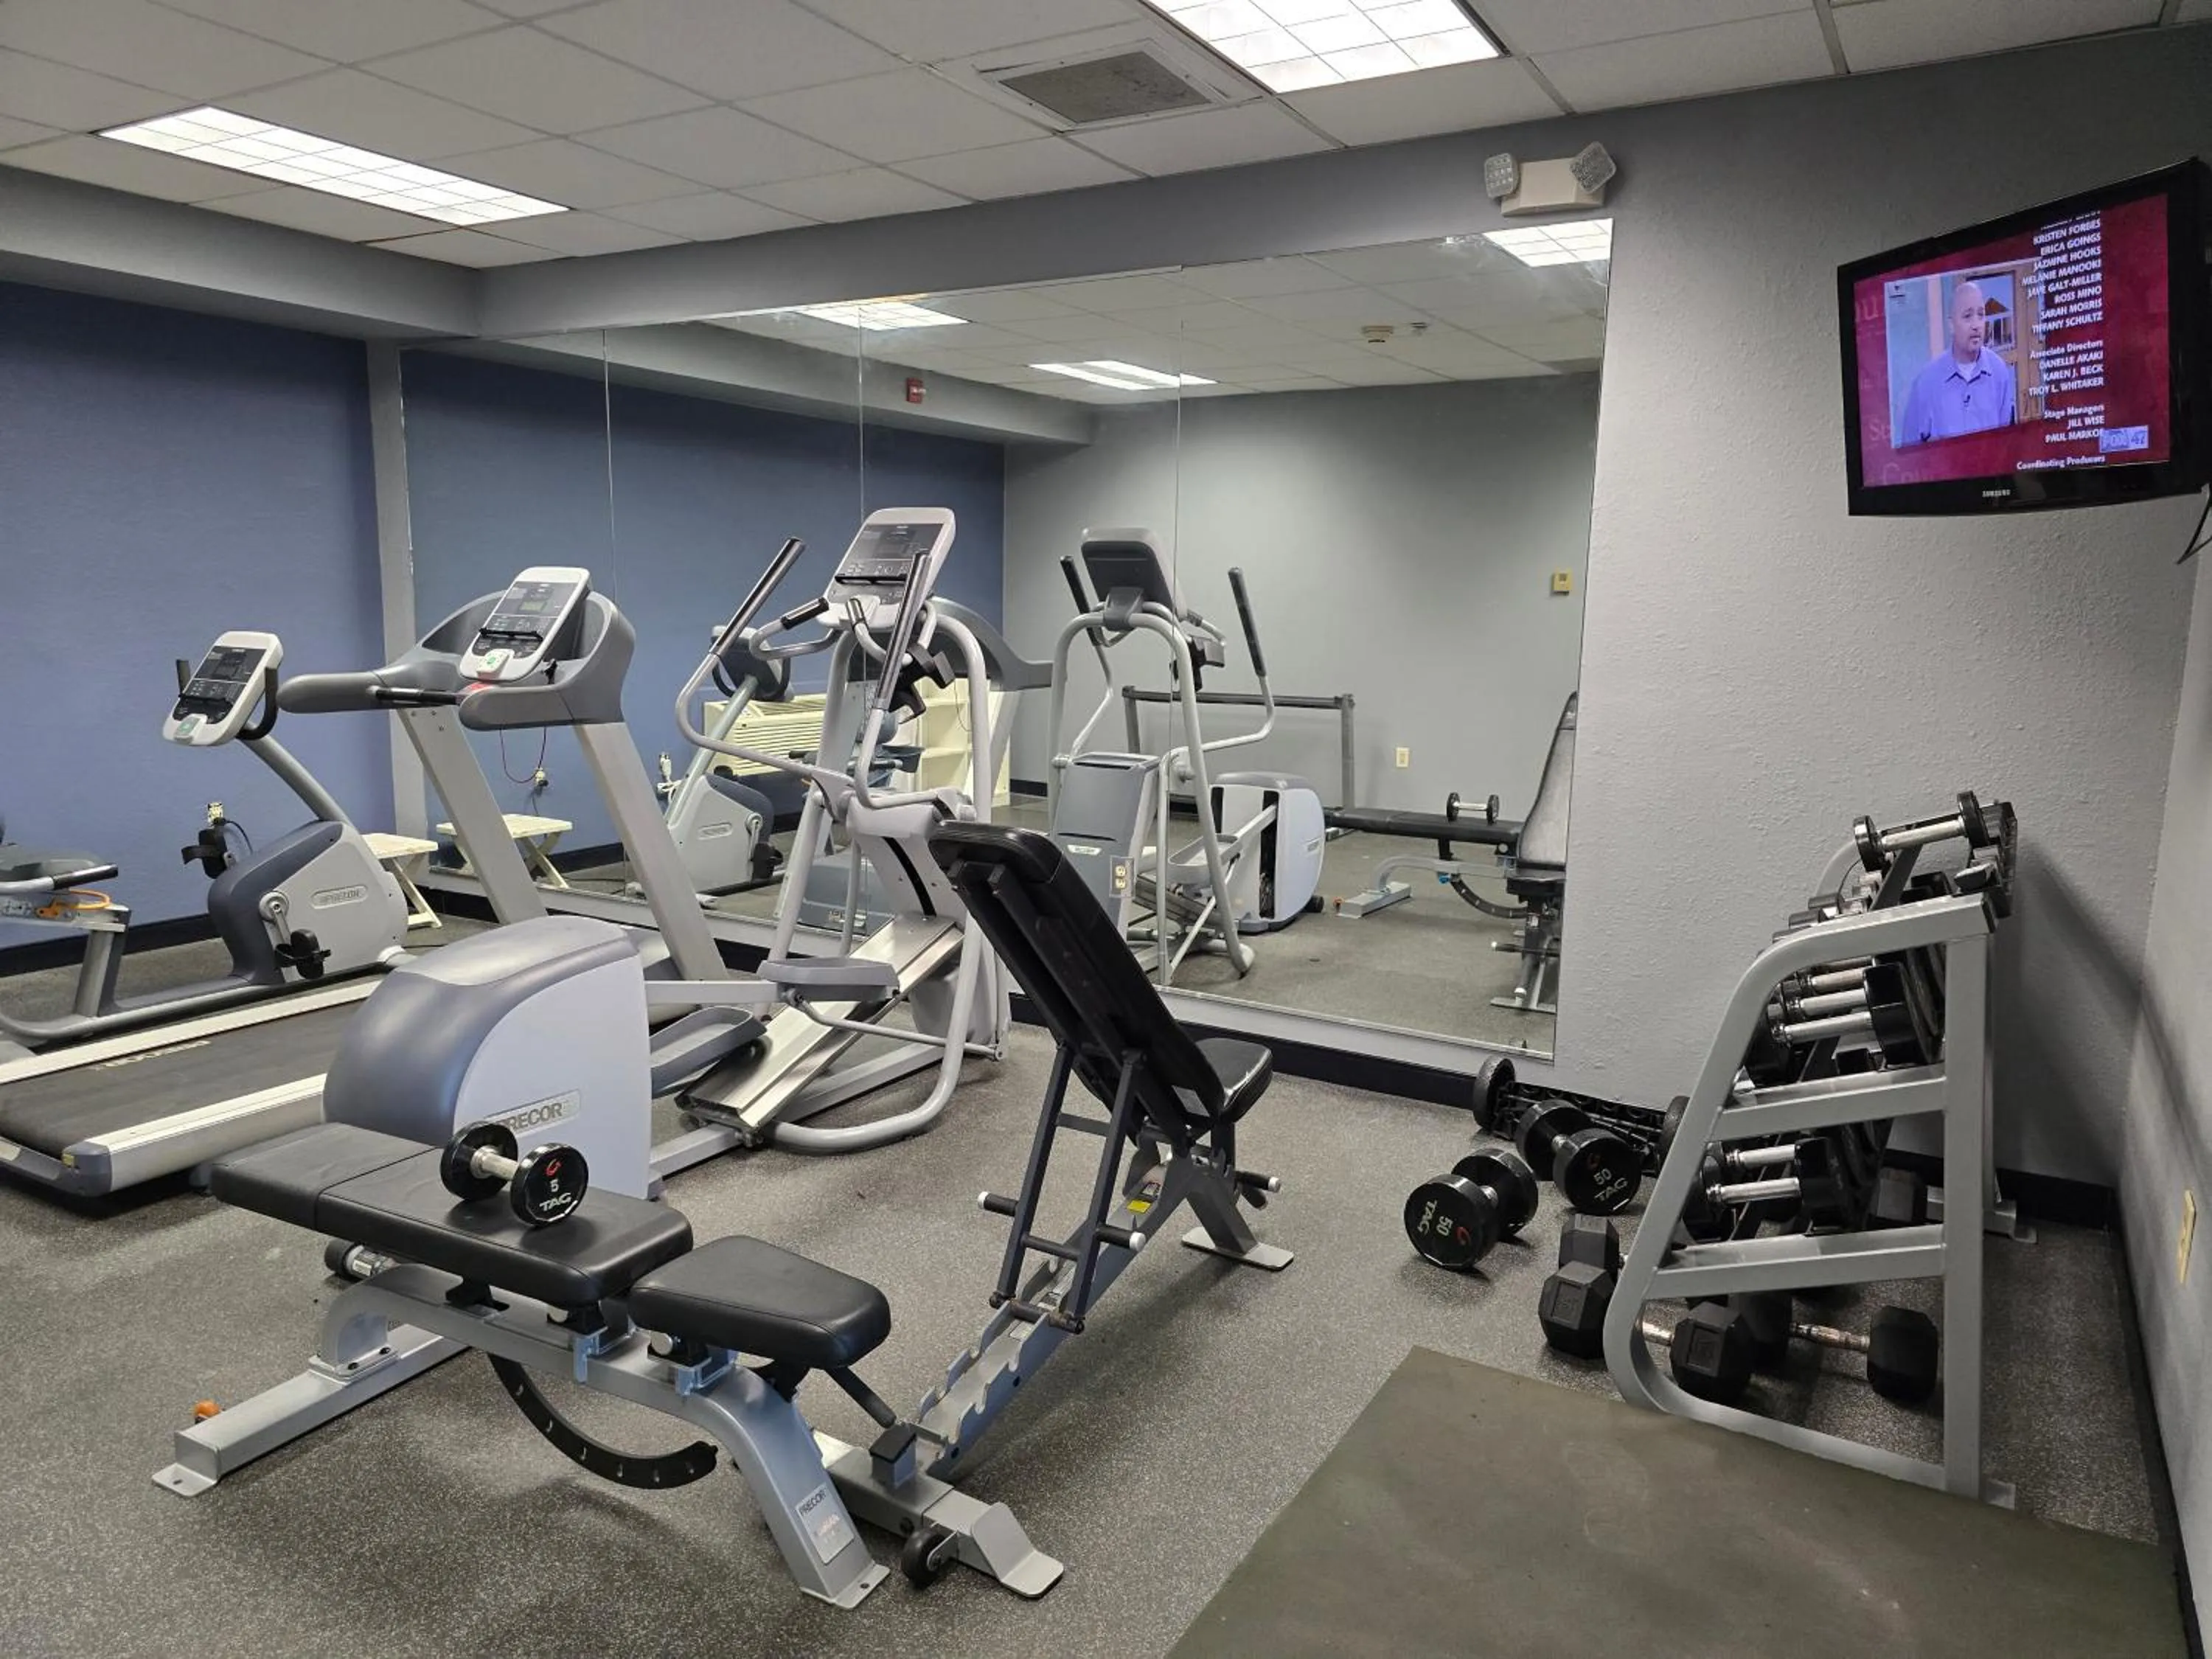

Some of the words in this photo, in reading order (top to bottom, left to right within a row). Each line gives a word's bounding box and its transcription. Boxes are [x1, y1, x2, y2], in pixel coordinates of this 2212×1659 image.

[2033, 228, 2067, 246] KRISTEN
[2040, 242, 2065, 257] ERICA
[2067, 232, 2101, 248] GOINGS
[2070, 246, 2101, 261] HOOKS
[2022, 270, 2056, 286] MELANIE
[2048, 273, 2102, 293] GALT-MILLER
[2054, 291, 2076, 304] ROSS
[2040, 305, 2067, 319] SARAH
[2069, 298, 2103, 313] MORRIS
[2032, 319, 2064, 334] TIFFANY
[2065, 311, 2103, 327] SCHULTZ
[2030, 345, 2065, 359] Associate
[2067, 339, 2104, 352] Directors
[2043, 369, 2070, 381] KAREN
[2080, 364, 2104, 375] BECK
[2029, 384, 2050, 397] TROY
[2060, 377, 2104, 392] WHITAKER
[2045, 408, 2065, 420] Stage
[2067, 404, 2104, 417] Managers
[2067, 417, 2083, 430] JILL
[2045, 431, 2067, 443] PAUL
[2017, 456, 2065, 470] Coordinating
[550, 1179, 560, 1192] 5
[1593, 1168, 1612, 1185] 50
[1594, 1178, 1628, 1201] TAG
[539, 1192, 571, 1211] TAG
[1417, 1199, 1438, 1236] TAG
[1436, 1215, 1453, 1237] 50
